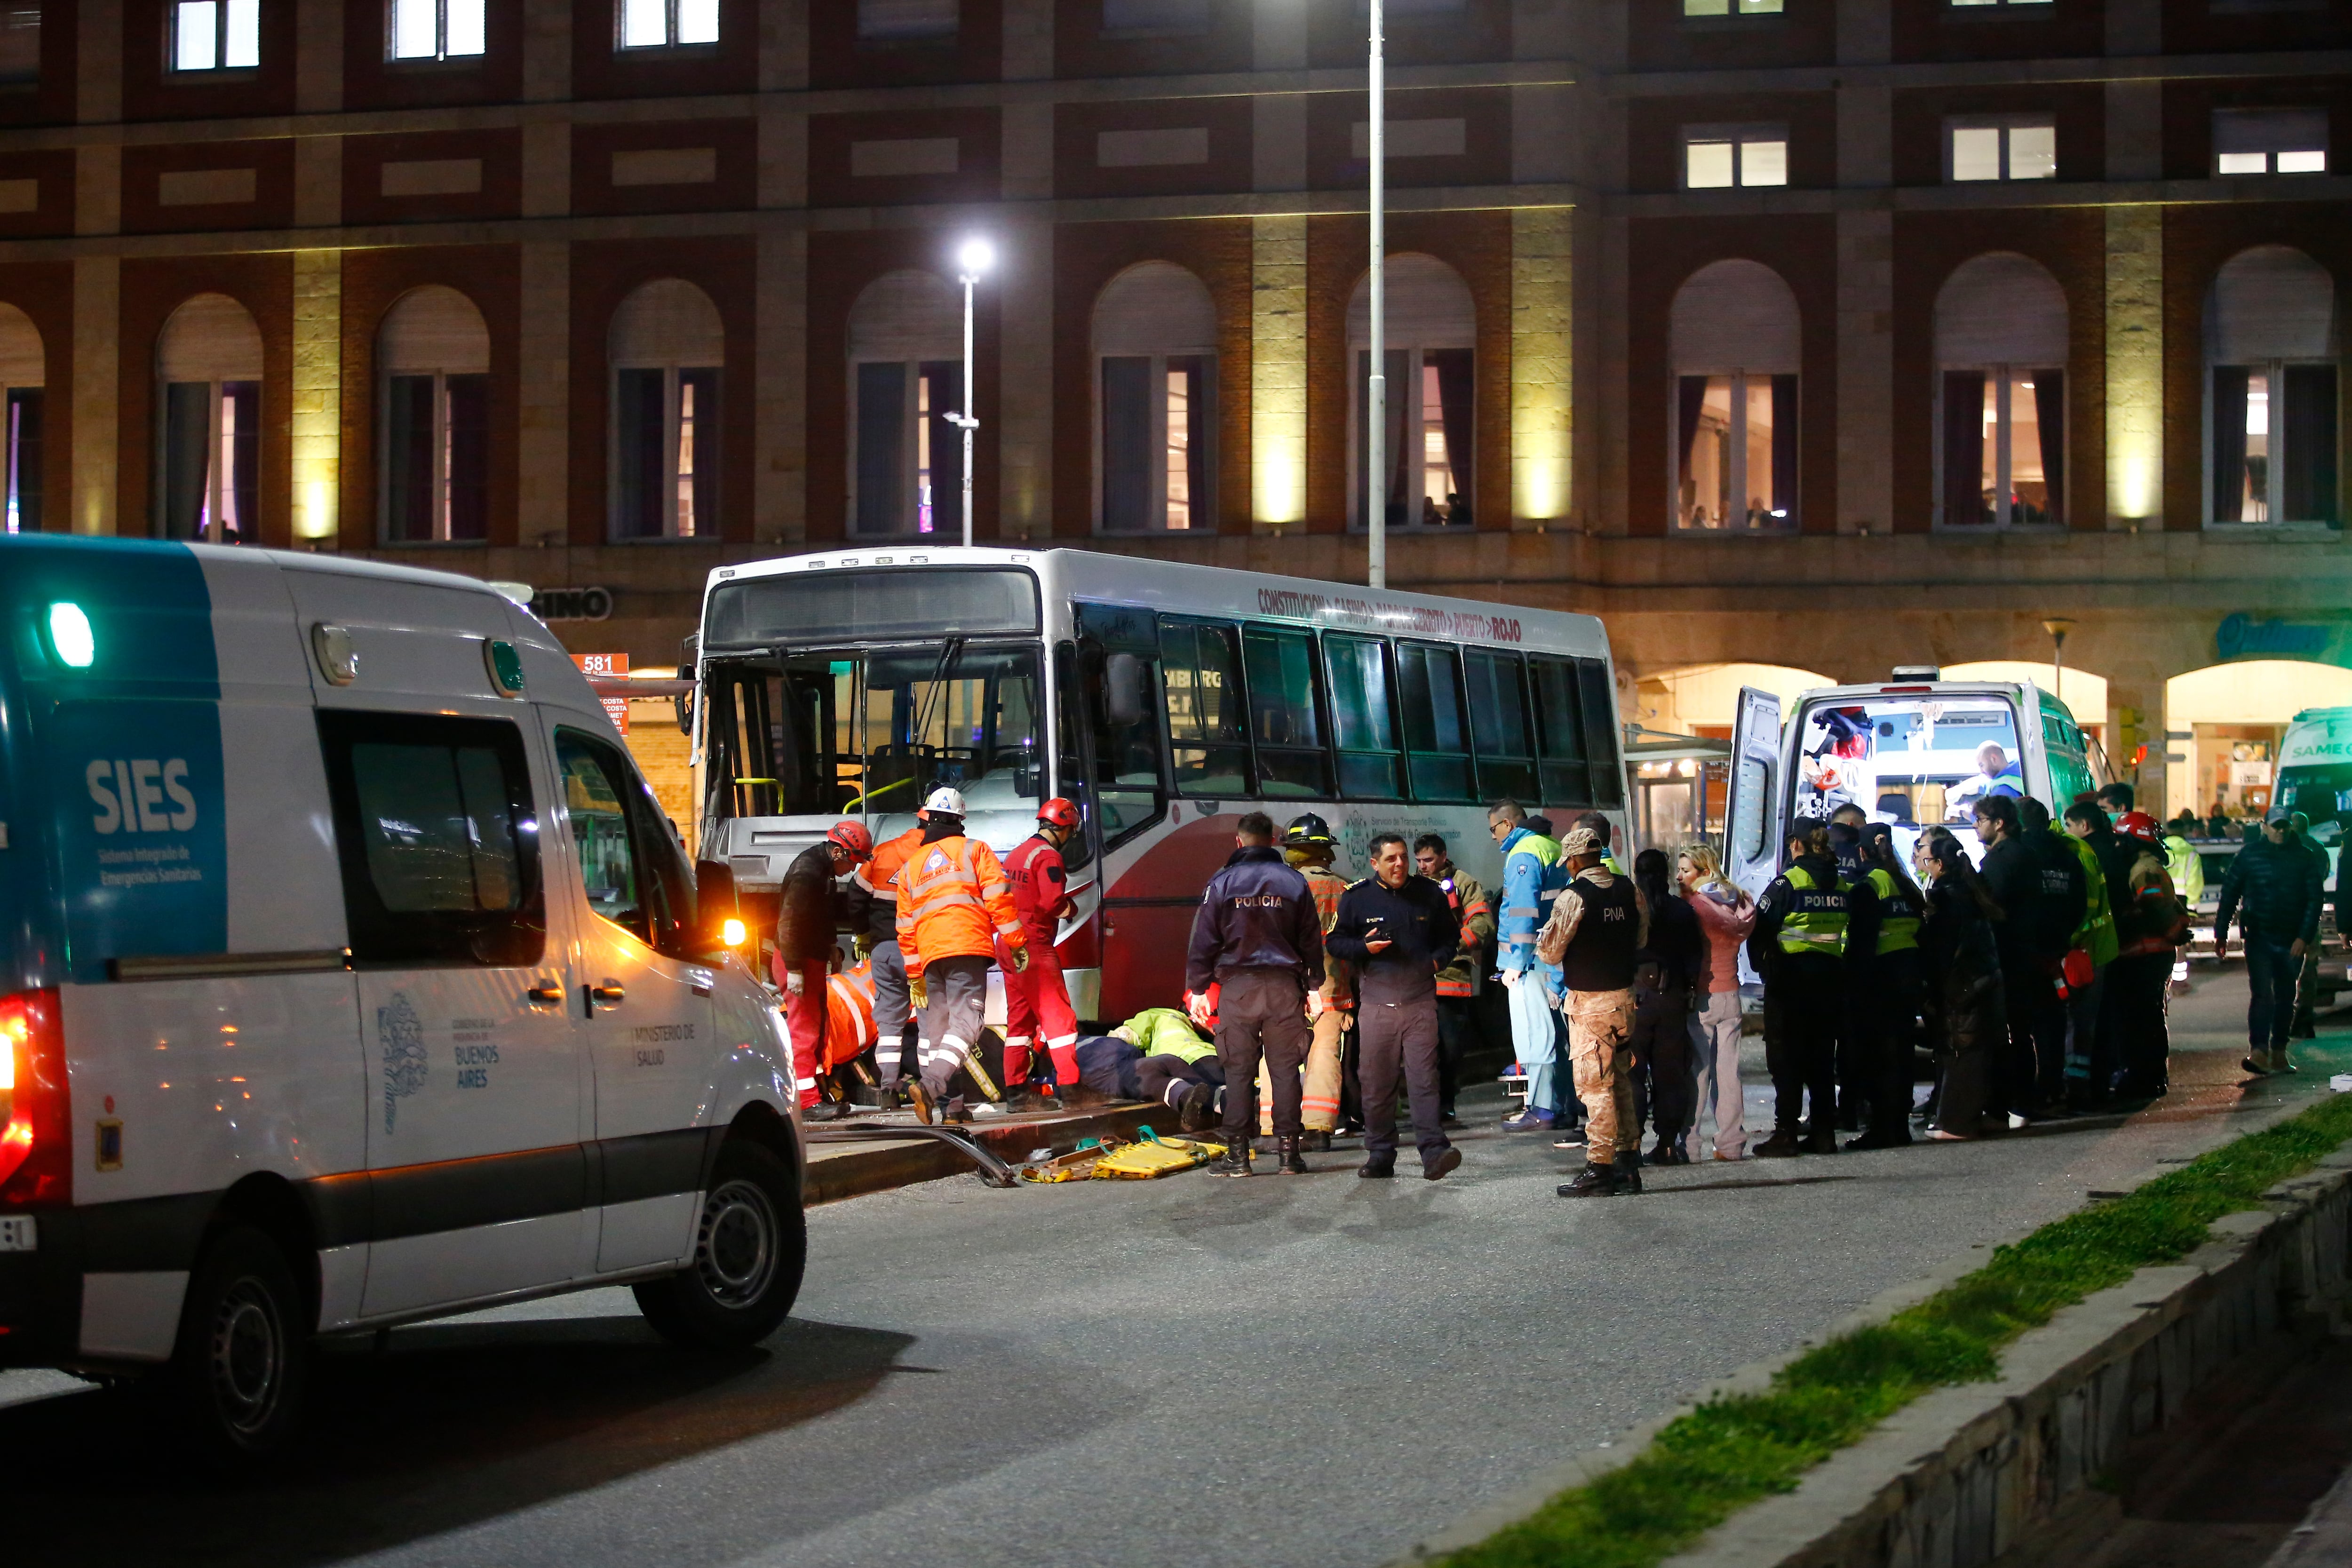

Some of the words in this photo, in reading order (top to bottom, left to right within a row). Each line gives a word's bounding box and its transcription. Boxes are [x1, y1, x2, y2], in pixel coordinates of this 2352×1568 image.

[1258, 588, 1327, 621] CONSTITUCION
[1491, 617, 1521, 643] ROJO
[584, 655, 612, 671] 581
[2292, 743, 2342, 758] SAME
[86, 758, 197, 835] SIES
[1234, 895, 1282, 908] POLICIA
[1804, 895, 1847, 907] POLICI
[1604, 907, 1625, 922] PNA
[635, 1024, 682, 1042] MINISTERIO
[683, 1023, 695, 1040] DE
[454, 1045, 500, 1065] BUENOS
[636, 1049, 665, 1067] SALUD
[456, 1068, 488, 1089] AIRES
